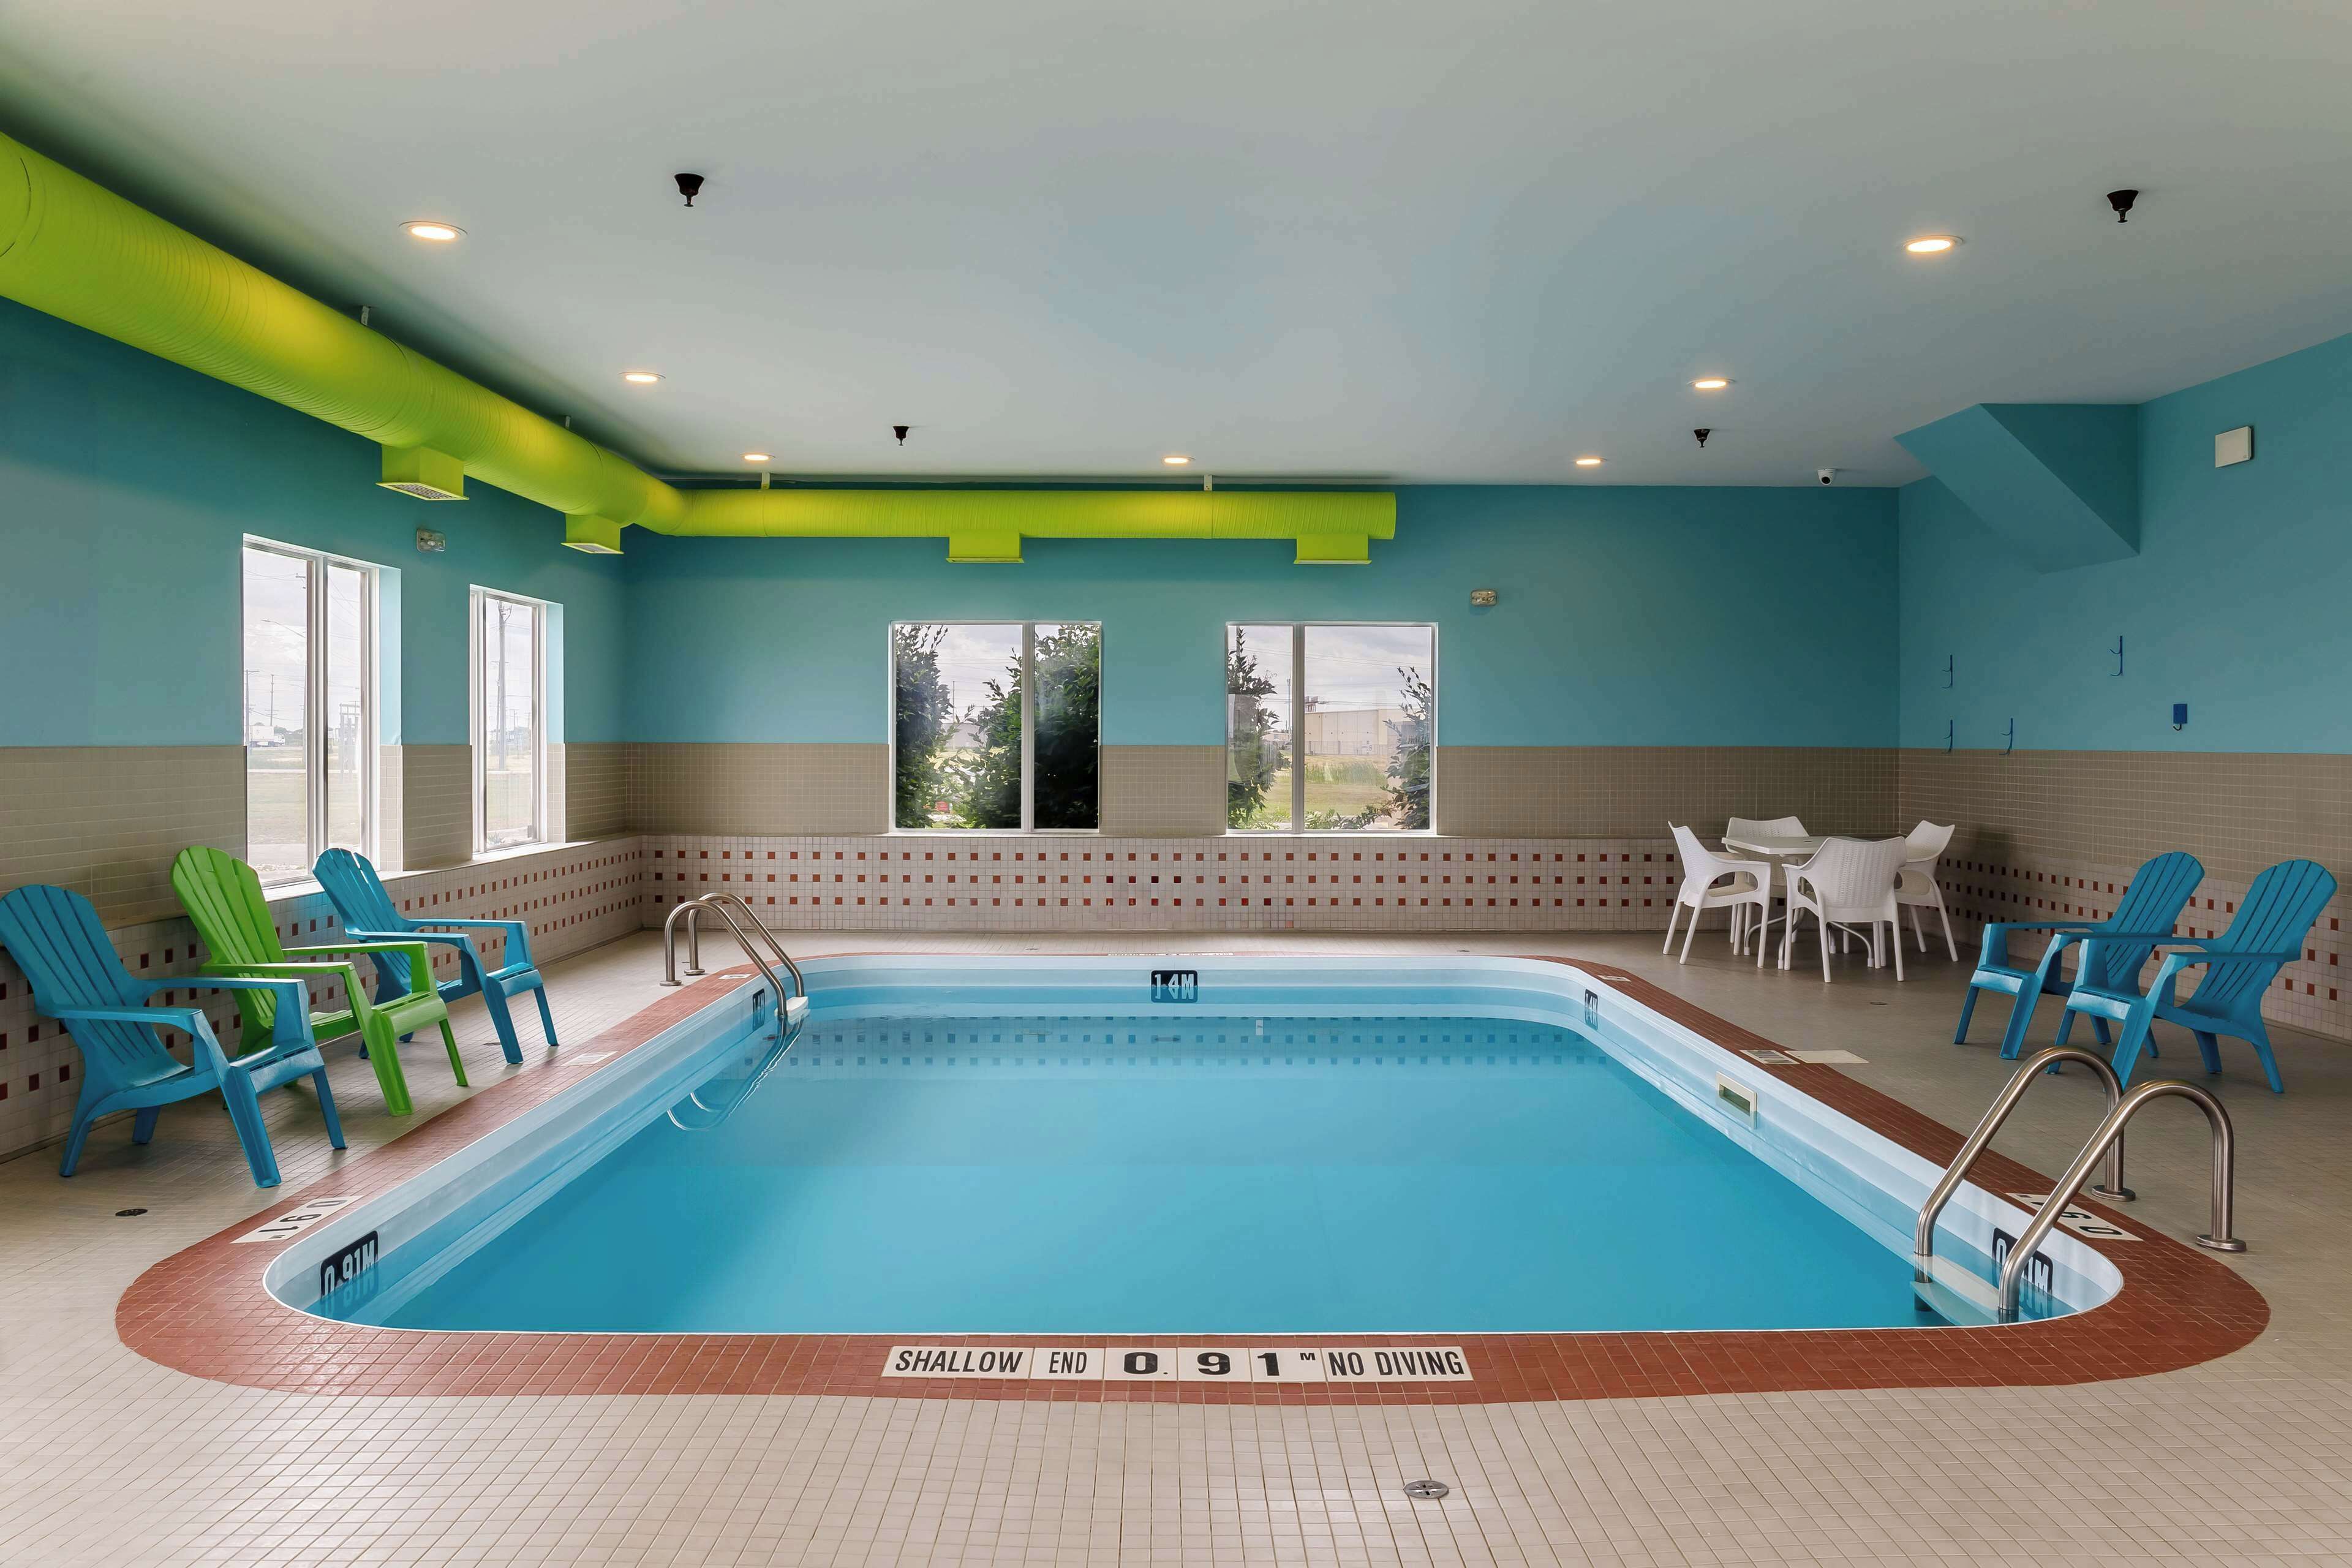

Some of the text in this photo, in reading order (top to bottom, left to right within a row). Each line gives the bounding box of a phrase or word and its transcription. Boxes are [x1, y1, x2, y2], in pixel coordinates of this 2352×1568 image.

[325, 1240, 374, 1295] 091M
[895, 1351, 1023, 1373] SHALLOW
[1049, 1352, 1087, 1374] END
[1328, 1352, 1364, 1376] NO
[1374, 1351, 1464, 1376] DIVING
